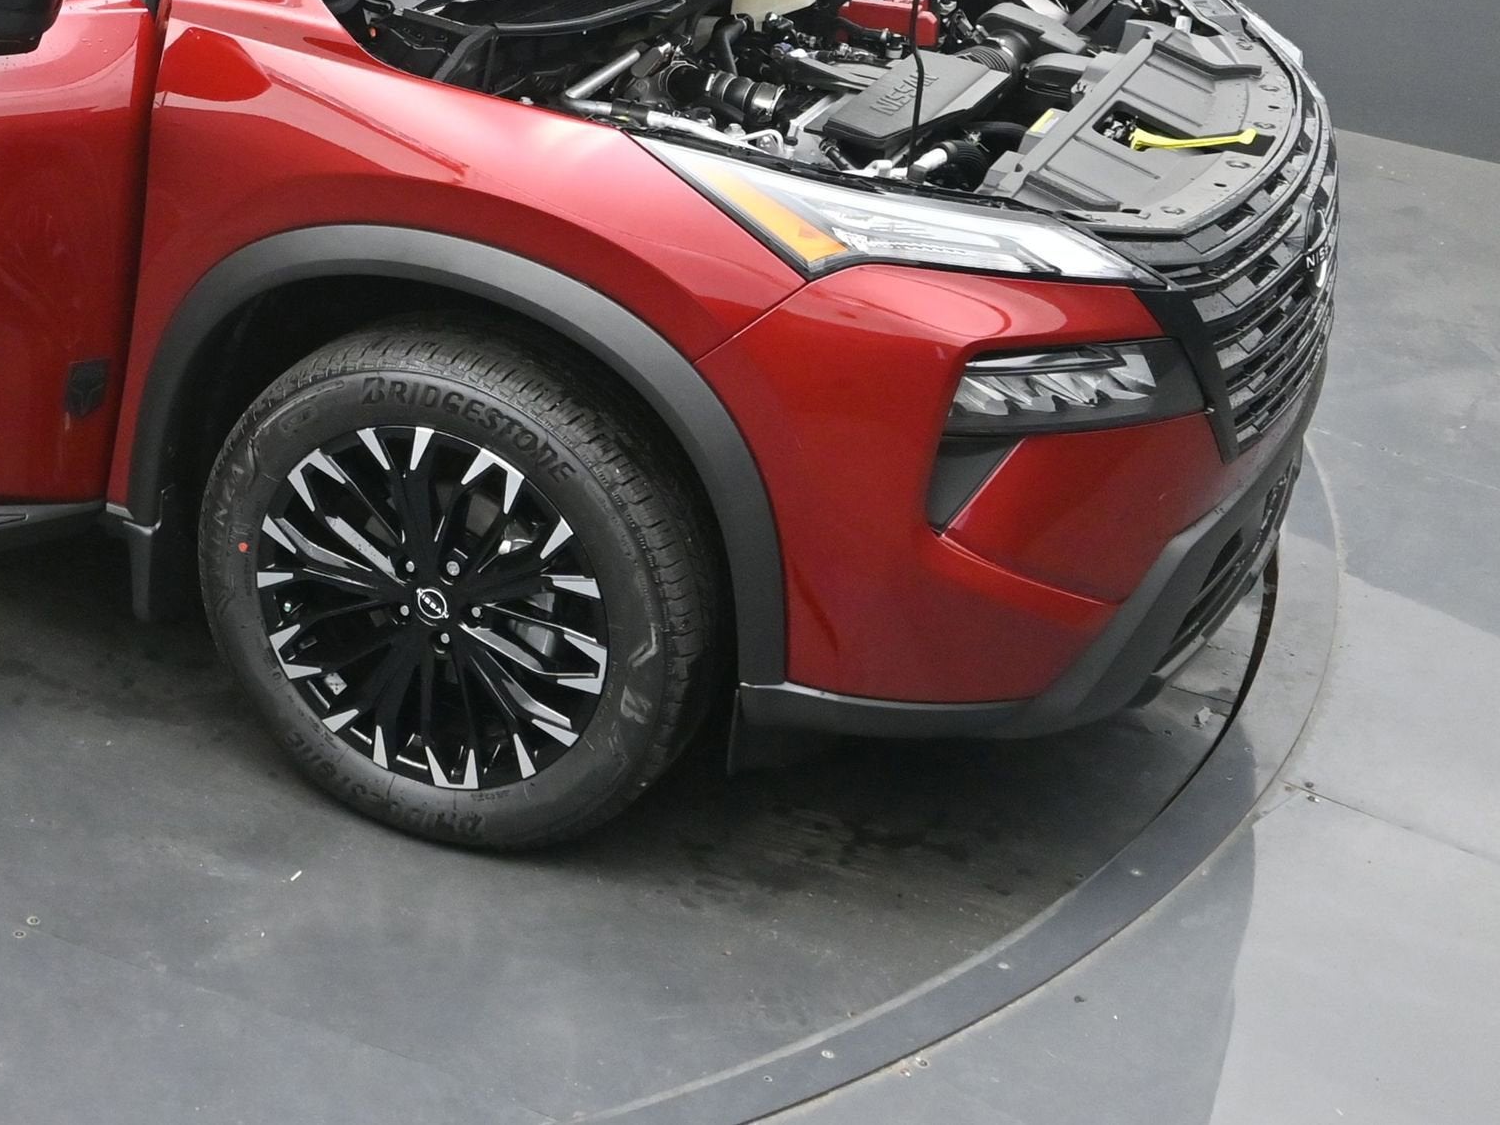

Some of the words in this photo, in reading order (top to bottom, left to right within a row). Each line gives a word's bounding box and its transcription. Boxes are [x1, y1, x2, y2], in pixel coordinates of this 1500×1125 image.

[870, 71, 939, 115] NISSAN
[1305, 244, 1331, 269] NISS
[360, 376, 578, 484] BRIDGESTONE
